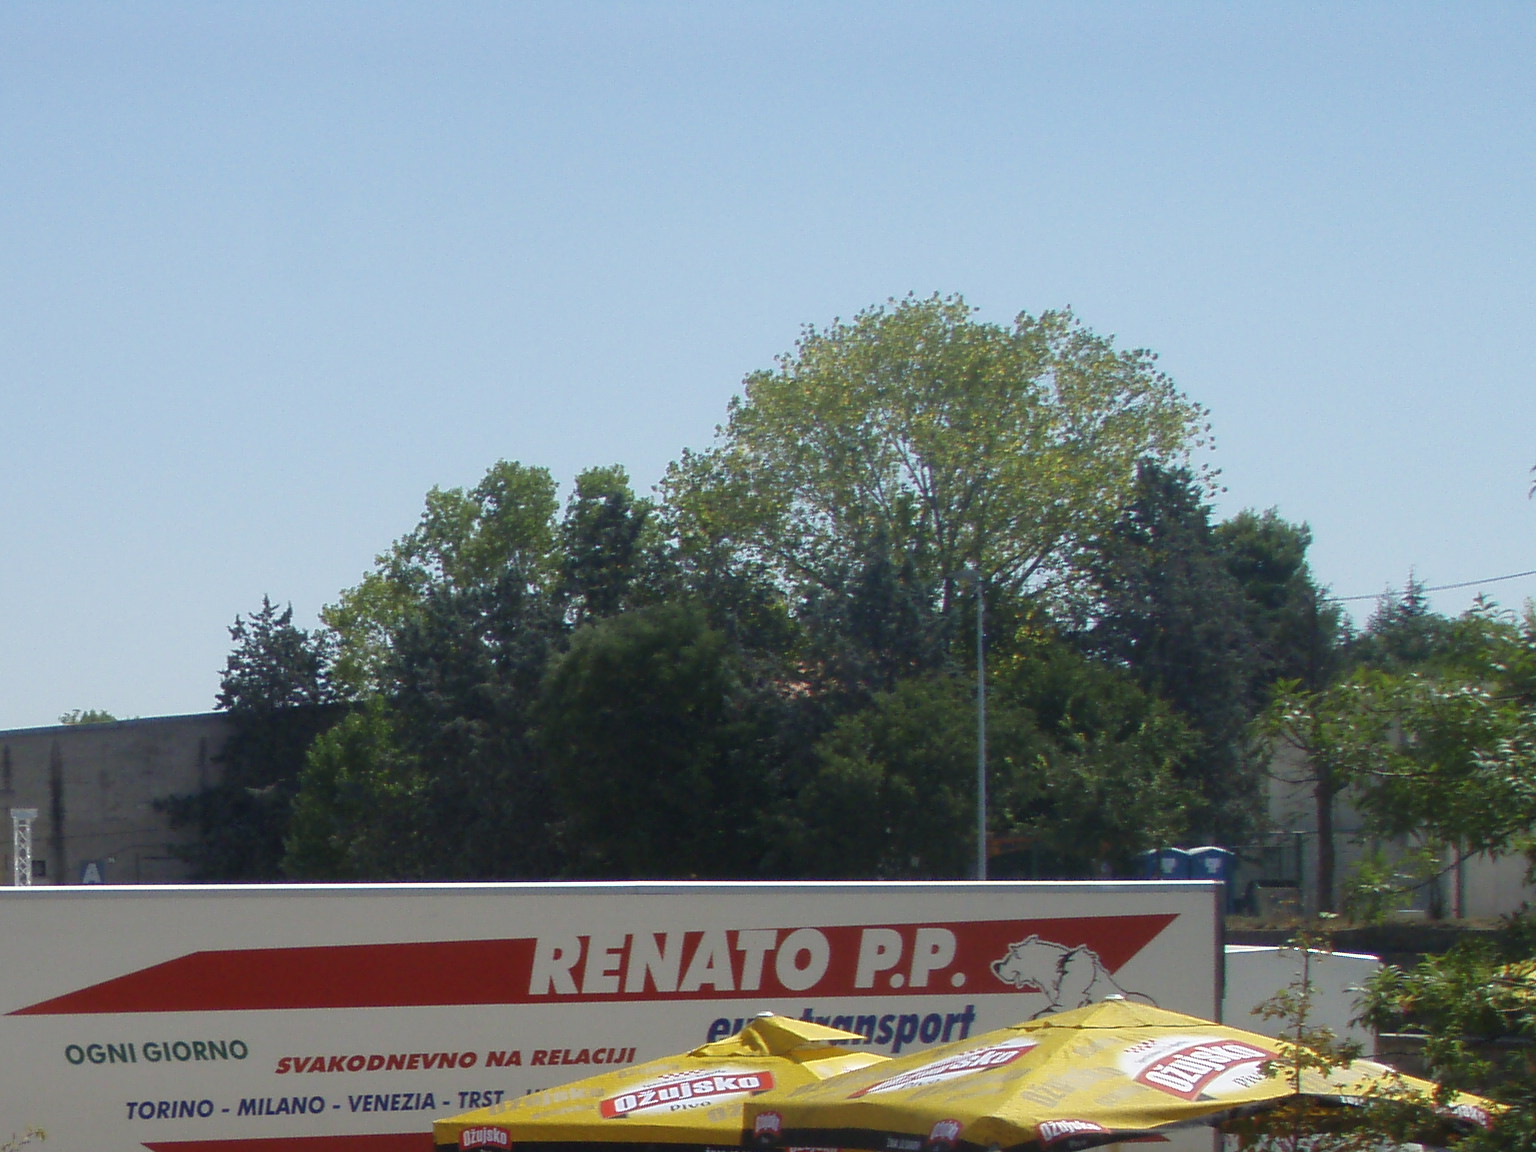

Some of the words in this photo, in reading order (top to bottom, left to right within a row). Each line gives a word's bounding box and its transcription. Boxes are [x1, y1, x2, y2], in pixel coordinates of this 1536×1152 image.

[528, 927, 831, 996] RENATO
[854, 926, 967, 990] P.P.
[707, 1003, 976, 1053] euansport
[64, 1042, 137, 1065] OGNI
[142, 1039, 249, 1063] GIORNO
[275, 1049, 477, 1075] SVAKODNEVNO
[485, 1049, 522, 1068] NA
[530, 1047, 637, 1067] RELACIJI
[126, 1099, 214, 1120] TORINO
[237, 1096, 326, 1116] MILANO
[348, 1092, 436, 1113] VENEZIA
[458, 1089, 504, 1109] TRST
[614, 1073, 763, 1114] Ožujsko
[463, 1127, 508, 1147] Ožujsko
